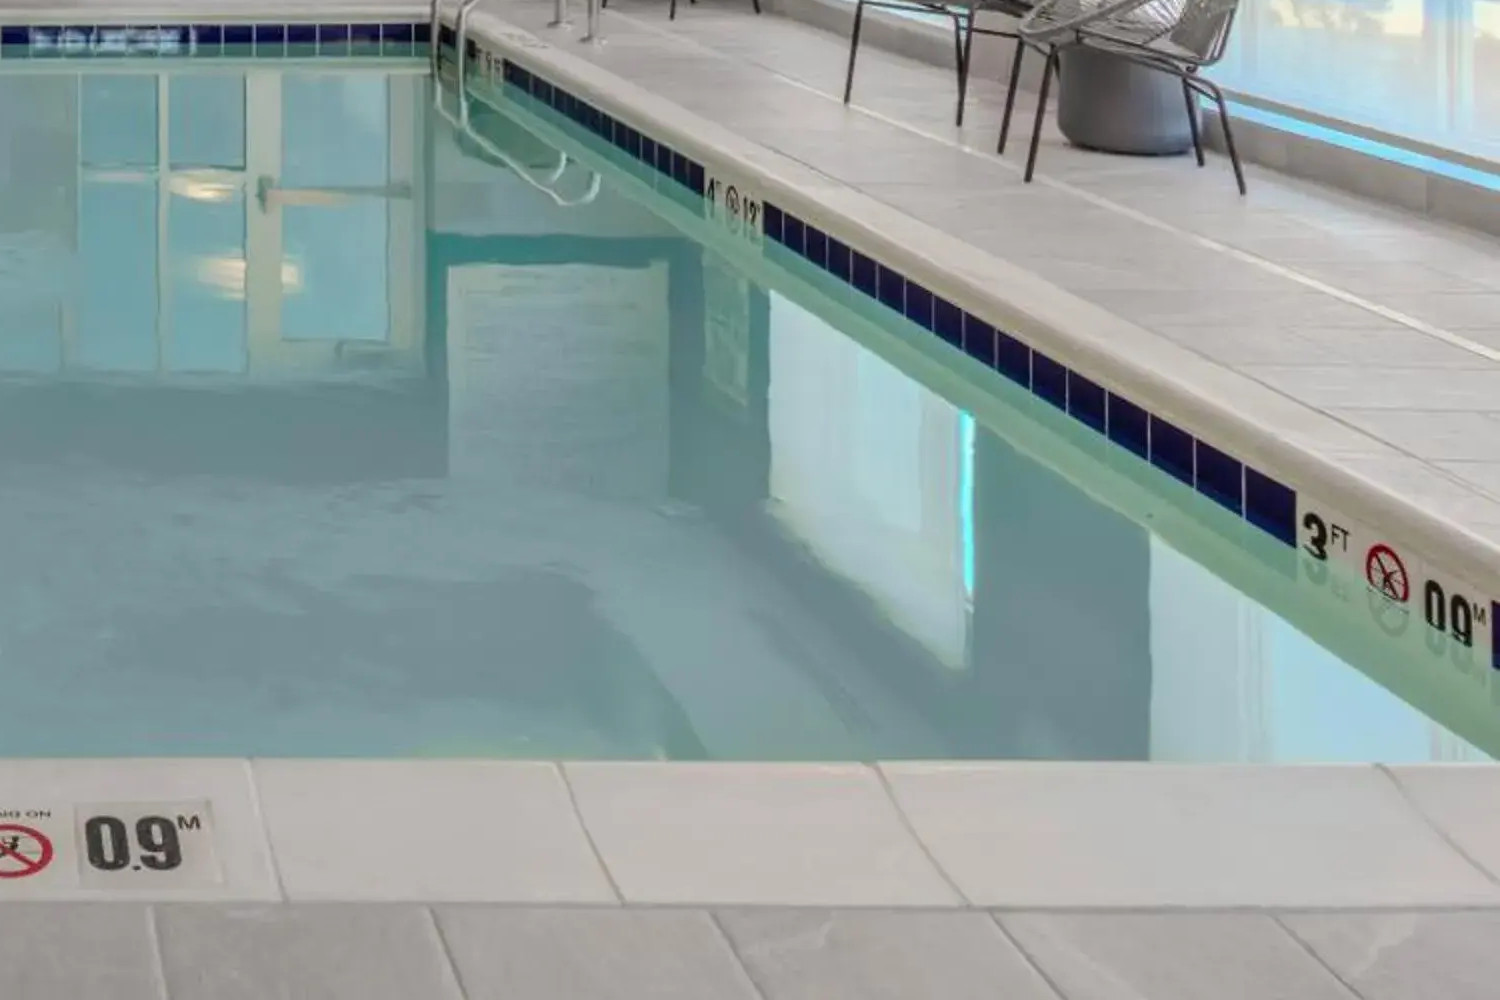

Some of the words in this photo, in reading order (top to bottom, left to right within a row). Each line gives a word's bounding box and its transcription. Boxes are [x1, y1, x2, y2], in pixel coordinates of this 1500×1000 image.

[1303, 512, 1327, 561] 3
[1331, 523, 1351, 552] FT
[84, 815, 182, 871] 0.9
[177, 813, 201, 830] M
